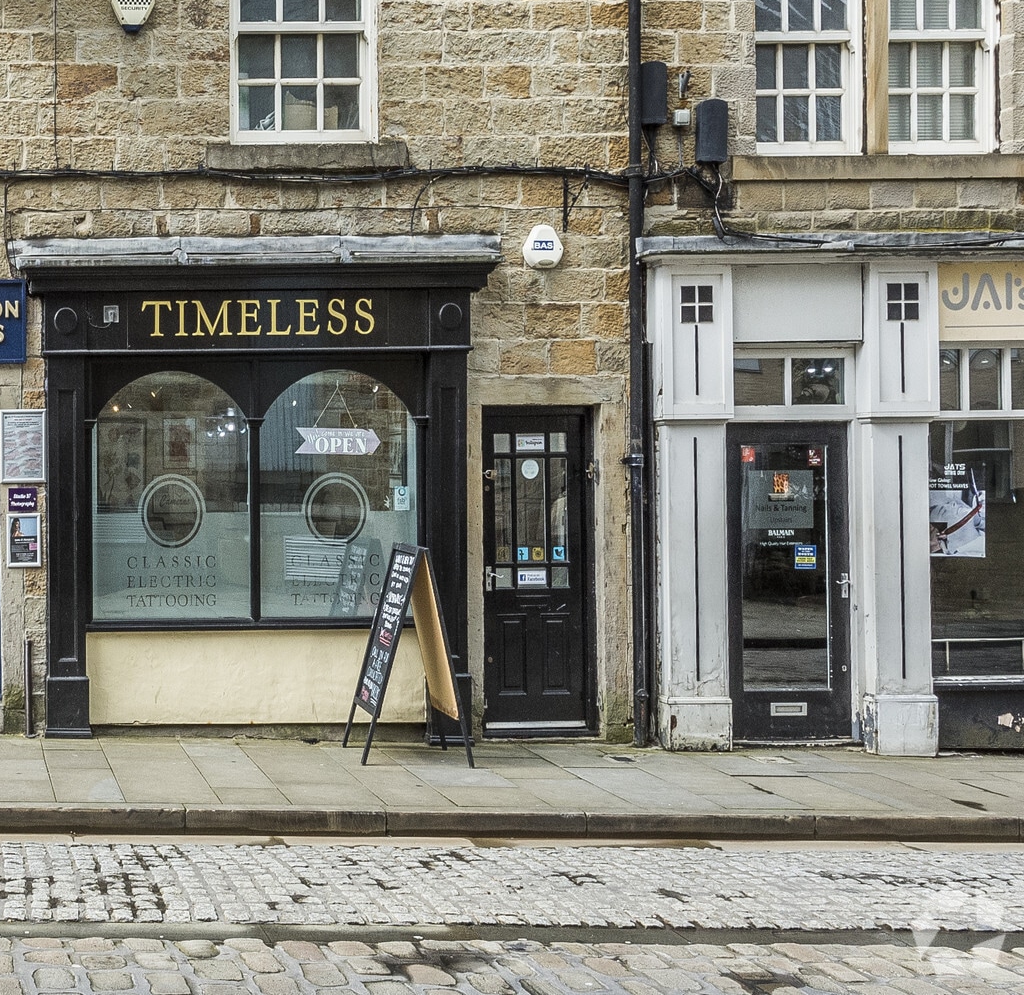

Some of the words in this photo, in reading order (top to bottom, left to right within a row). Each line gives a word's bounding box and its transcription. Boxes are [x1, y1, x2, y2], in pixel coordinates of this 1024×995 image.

[141, 298, 375, 337] TIMELESS
[315, 437, 367, 454] OPEN
[756, 504, 772, 512] Nails
[773, 504, 779, 512] &
[781, 504, 807, 514] Tanning
[126, 555, 217, 570] CLASSIC
[126, 574, 217, 589] ELECTRIC
[125, 593, 217, 608] TATTOOING
